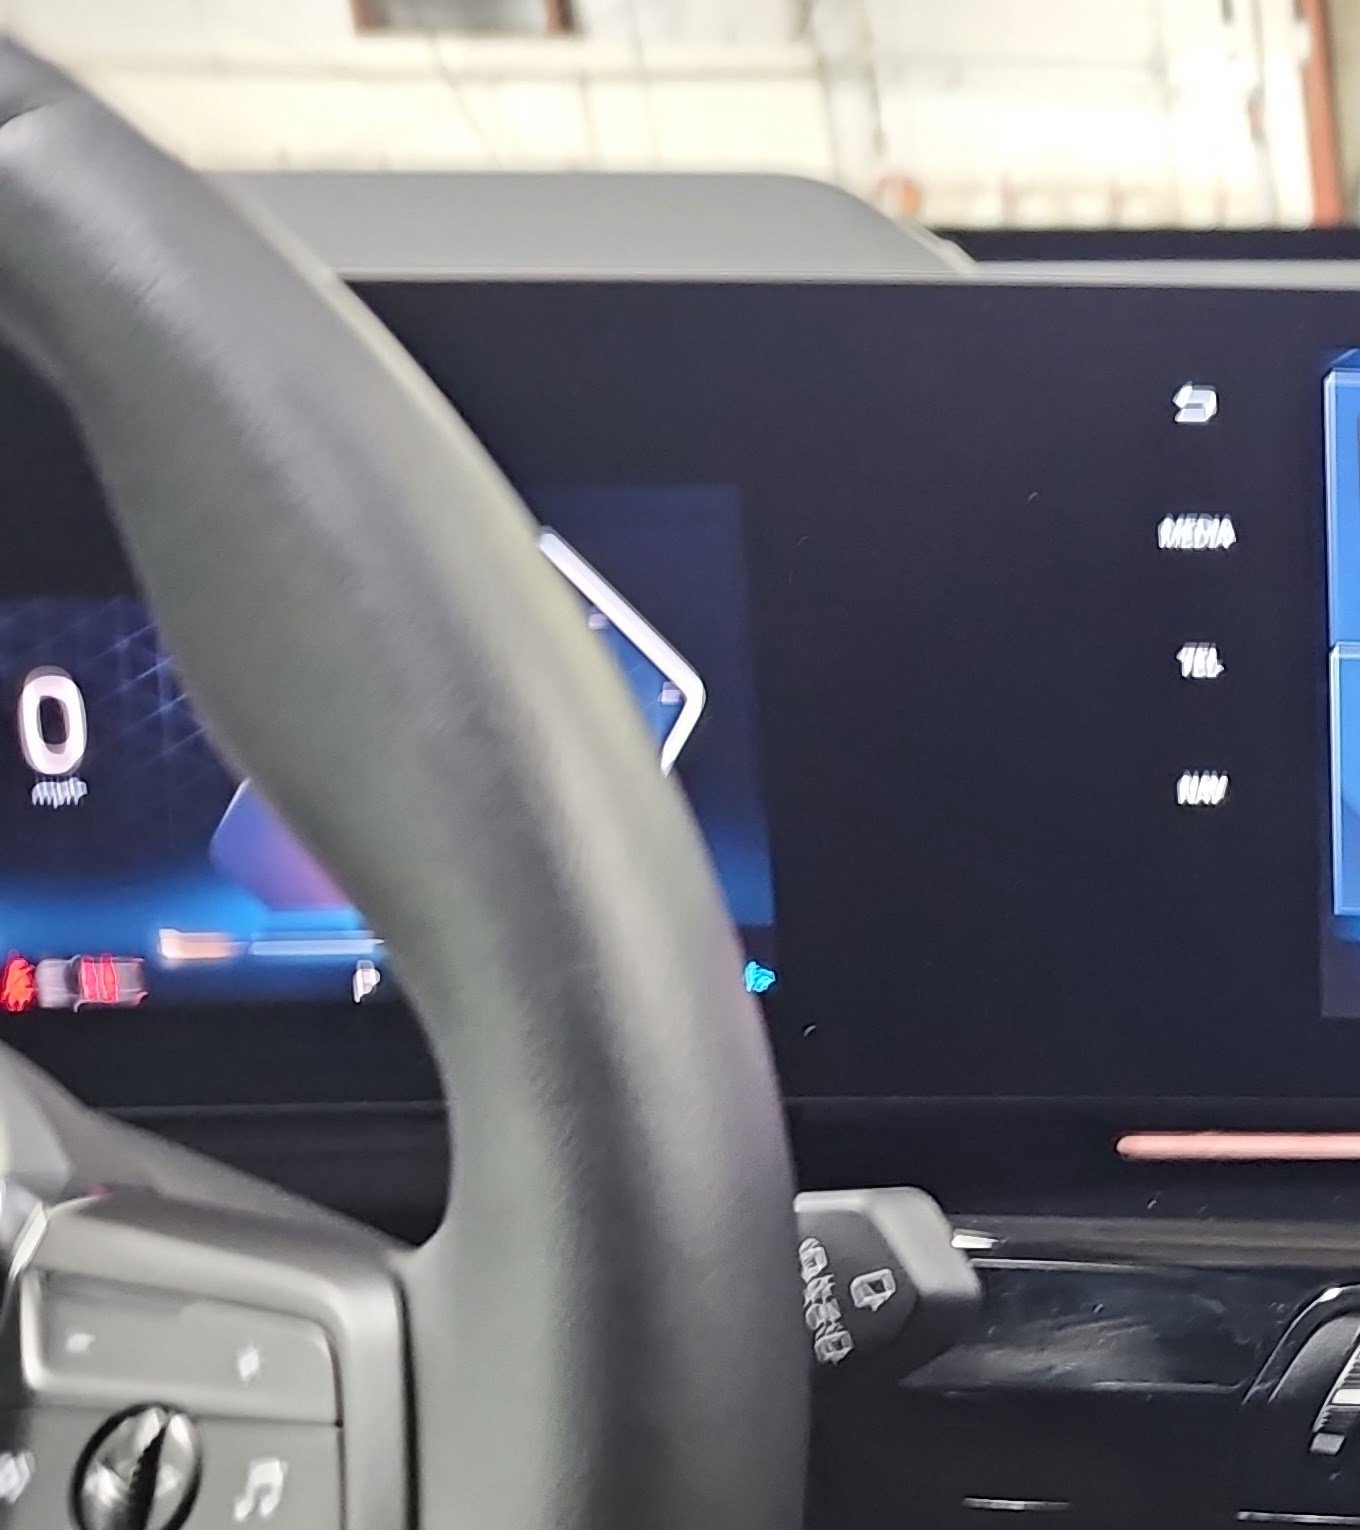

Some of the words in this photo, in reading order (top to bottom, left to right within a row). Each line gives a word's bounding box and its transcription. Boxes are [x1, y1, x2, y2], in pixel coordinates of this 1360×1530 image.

[1157, 513, 1237, 549] MEDIA
[1176, 643, 1225, 678] TEL
[17, 665, 88, 775] 0
[1177, 769, 1229, 805] NAV
